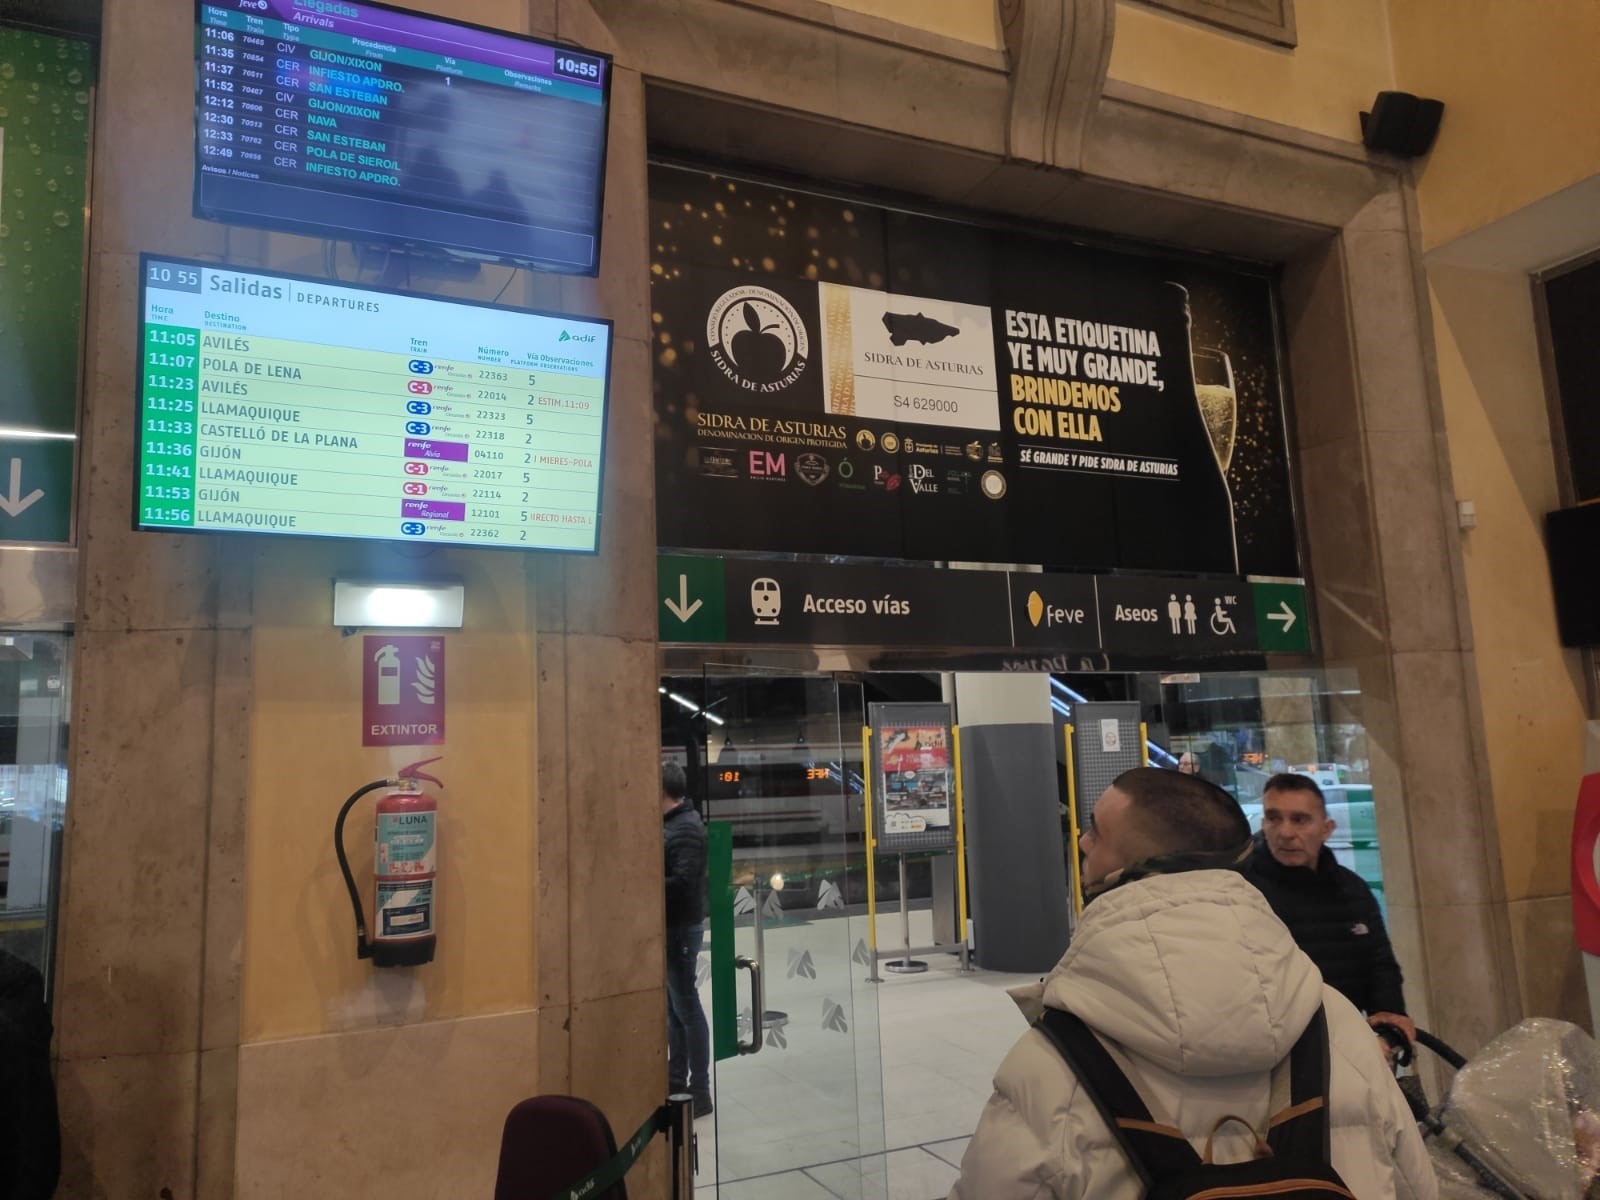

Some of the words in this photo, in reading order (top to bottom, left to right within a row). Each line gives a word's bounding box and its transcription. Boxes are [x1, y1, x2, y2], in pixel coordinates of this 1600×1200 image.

[208, 6, 228, 17] Hora
[247, 15, 264, 26] Tren
[293, 12, 334, 28] Arrivals
[283, 23, 300, 33] Tipo
[205, 28, 234, 42] 11:06
[277, 42, 295, 54] CIV
[310, 49, 382, 72] GIJON/XIXON
[445, 77, 451, 87] 1
[352, 37, 396, 54] Procedencia
[205, 45, 234, 59] 11:35
[276, 59, 300, 71] CER
[309, 65, 360, 84] INFIESTO
[362, 74, 405, 93] APDRO.
[504, 69, 552, 86] Observaciones
[557, 57, 598, 78] 10:55
[205, 62, 234, 75] 11:37
[276, 75, 300, 88] CER
[309, 82, 332, 94] SAN
[335, 87, 388, 105] ESTEBAN
[205, 78, 233, 92] 11:52
[276, 92, 294, 104] CIV
[308, 98, 380, 120] GIJON/XIXON
[205, 95, 234, 109] 12:12
[275, 108, 299, 120] CER
[307, 114, 337, 128] NAVA
[204, 112, 233, 125] 12:30
[275, 124, 298, 136] CER
[307, 130, 330, 142] SAN
[333, 134, 386, 152] ESTEBAN
[204, 129, 233, 141] 12:33
[274, 140, 297, 153] CER
[306, 146, 338, 160] POLA
[340, 152, 355, 163] DE
[358, 155, 400, 171] SIERO/L
[202, 165, 226, 175] Avisos
[231, 168, 259, 179] Notices
[274, 156, 297, 168] CER
[306, 162, 357, 179] INFIESTO
[359, 171, 401, 187] APDRO.
[150, 268, 171, 282] 10
[178, 270, 198, 285] 55
[210, 275, 282, 300] Salidas
[297, 292, 380, 313] DEPARTURES
[152, 304, 174, 315] Hora
[204, 311, 240, 322] Destino
[410, 338, 428, 347] Tren
[478, 346, 509, 357] Número
[528, 352, 538, 361] Vía
[541, 354, 593, 368] Observaciones
[204, 320, 247, 331] DESTINATION
[572, 333, 596, 344] adif
[1005, 309, 1052, 341] ESTA
[1054, 316, 1162, 357] ETIQUETINA
[150, 330, 196, 346] 11:05
[203, 334, 249, 352] AVILÉS
[410, 361, 432, 373] C-3
[478, 370, 508, 381] 22363
[529, 375, 536, 386] 5
[710, 350, 740, 385] SIDRA
[742, 379, 757, 392] DE
[760, 361, 806, 393] ASTURIAS
[864, 352, 903, 367] SIDRA
[907, 358, 922, 369] DE
[926, 360, 984, 376] ASTURIAS
[1007, 341, 1034, 371] YE
[1036, 345, 1079, 376] MUY
[1083, 352, 1164, 392] GRANDE,
[149, 352, 195, 368] 11:07
[203, 358, 238, 373] POLA
[244, 362, 262, 375] DE
[268, 365, 301, 381] LENA
[409, 382, 430, 394] C-1
[477, 390, 507, 402] 22014
[528, 394, 534, 405] 2
[564, 399, 590, 410] 11:09
[1010, 373, 1121, 413] BRINDEMOS
[149, 375, 194, 390] 11:23
[202, 379, 248, 396] AVILÉS
[407, 402, 430, 413] C-3
[476, 410, 505, 421] 22323
[526, 414, 533, 425] 5
[894, 395, 910, 408] S4
[912, 397, 958, 413] 629000
[147, 397, 193, 412] 11:25
[201, 401, 301, 422] LLAMAQUIQUE
[407, 422, 429, 433] C-3
[475, 430, 504, 441] 22318
[526, 433, 532, 445] 2
[697, 412, 746, 430] SIDRA
[750, 417, 770, 432] DE
[773, 420, 847, 440] ASTURIAS
[1013, 406, 1054, 437] CON
[1057, 411, 1103, 442] ELLA
[147, 419, 192, 434] 11:33
[200, 424, 265, 441] CASTELLÓ
[271, 430, 288, 442] DE
[294, 432, 309, 444] LA
[315, 434, 358, 449] PLANA
[474, 449, 504, 461] 04110
[524, 453, 531, 464] 2
[765, 434, 774, 443] DE
[776, 435, 806, 446] ORIGEN
[806, 438, 848, 449] PROTEGIDA
[146, 441, 192, 456] 11:36
[200, 444, 241, 460] GIJÓN
[405, 463, 426, 474] C-1
[473, 469, 502, 480] 22017
[523, 472, 530, 483] 5
[749, 450, 786, 477] EM
[913, 464, 935, 480] DEL
[1020, 448, 1032, 463] SÉ
[1033, 450, 1069, 466] GRANDE
[1071, 454, 1078, 466] Y
[1079, 455, 1098, 469] PIDE
[1100, 457, 1125, 471] SIDRA
[1126, 459, 1138, 472] DE
[1139, 461, 1178, 476] ASTURIAS
[146, 463, 191, 478] 11:41
[199, 466, 298, 486] LLAMAQUIQUE
[404, 483, 425, 494] C-1
[472, 489, 501, 500] 22114
[522, 492, 529, 503] 2
[909, 478, 939, 494] VALLE
[145, 485, 190, 500] 11:53
[198, 488, 240, 503] GIJÓN
[471, 508, 500, 519] 12101
[520, 511, 528, 522] 5
[530, 512, 560, 523] IRECTO
[562, 514, 586, 525] HASTA
[144, 507, 190, 522] 11:56
[198, 509, 297, 528] LLAMAQUIQUE
[402, 524, 424, 535] C-3
[470, 528, 499, 539] 22362
[519, 530, 526, 541] 2
[803, 593, 867, 614] Acceso
[872, 594, 911, 615] vías
[1114, 604, 1159, 622] Aseos
[1224, 595, 1238, 605] WC
[1046, 604, 1085, 628] feve
[371, 723, 438, 736] EXTINTOR
[398, 815, 428, 826] LUNA
